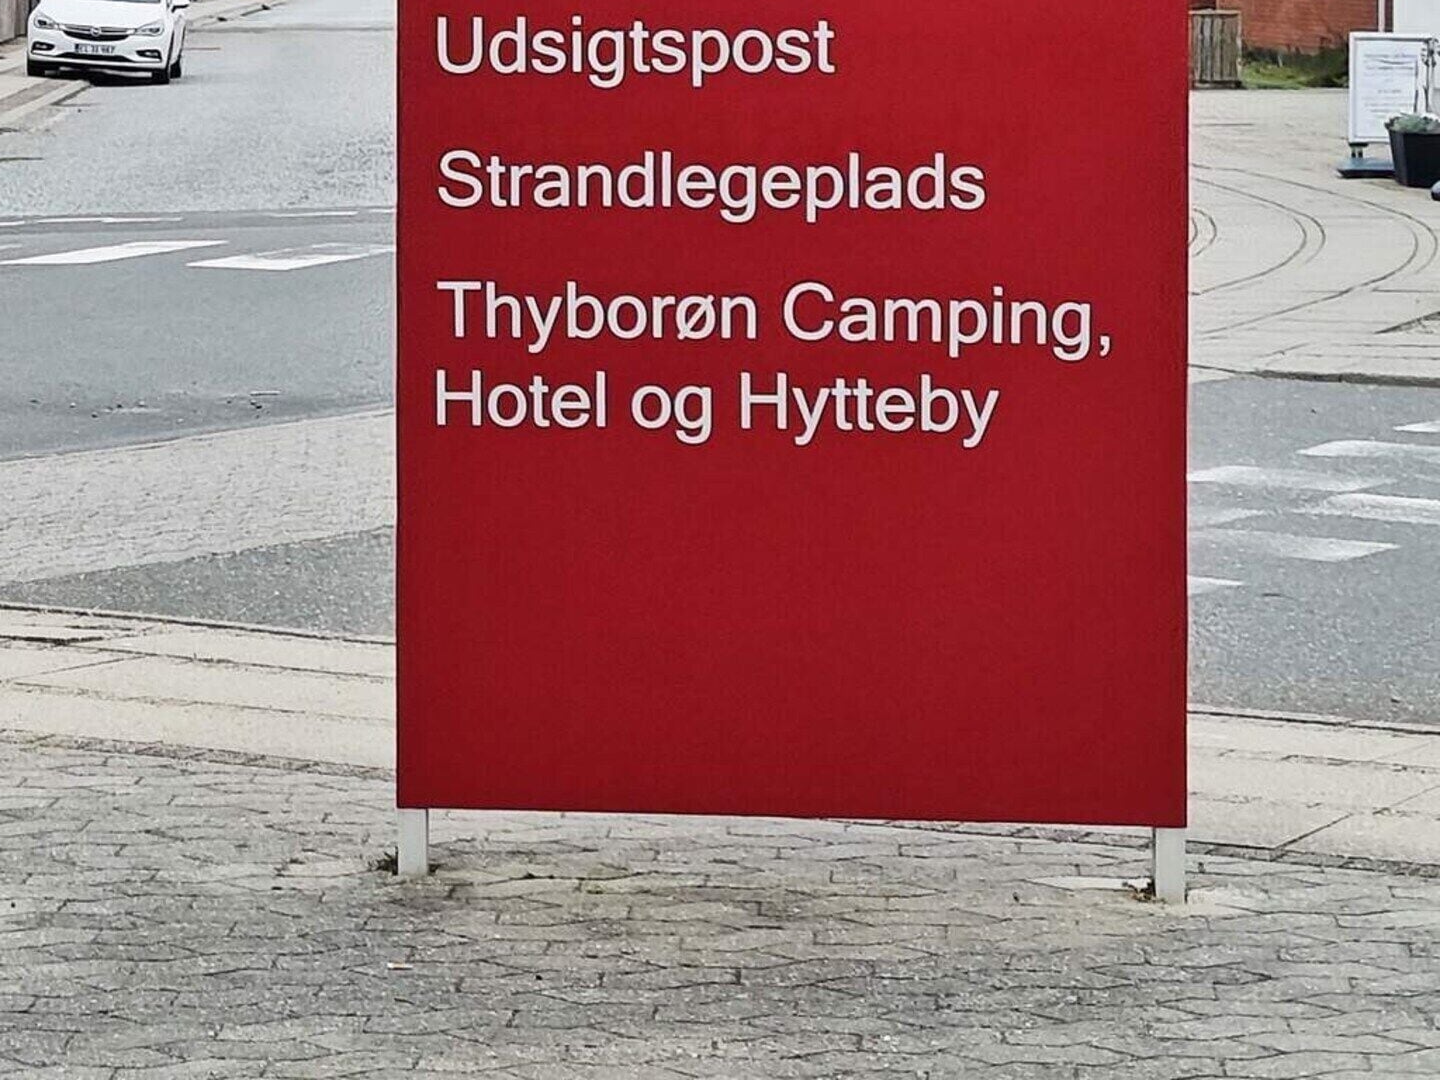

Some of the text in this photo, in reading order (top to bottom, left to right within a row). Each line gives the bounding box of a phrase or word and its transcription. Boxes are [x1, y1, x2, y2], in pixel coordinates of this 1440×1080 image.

[436, 15, 836, 89] Udsigtspost
[437, 149, 987, 224] Strandlegeplads
[435, 281, 1111, 362] Thyborøn Camping,
[434, 369, 1001, 449] Hotel og Hytteby
